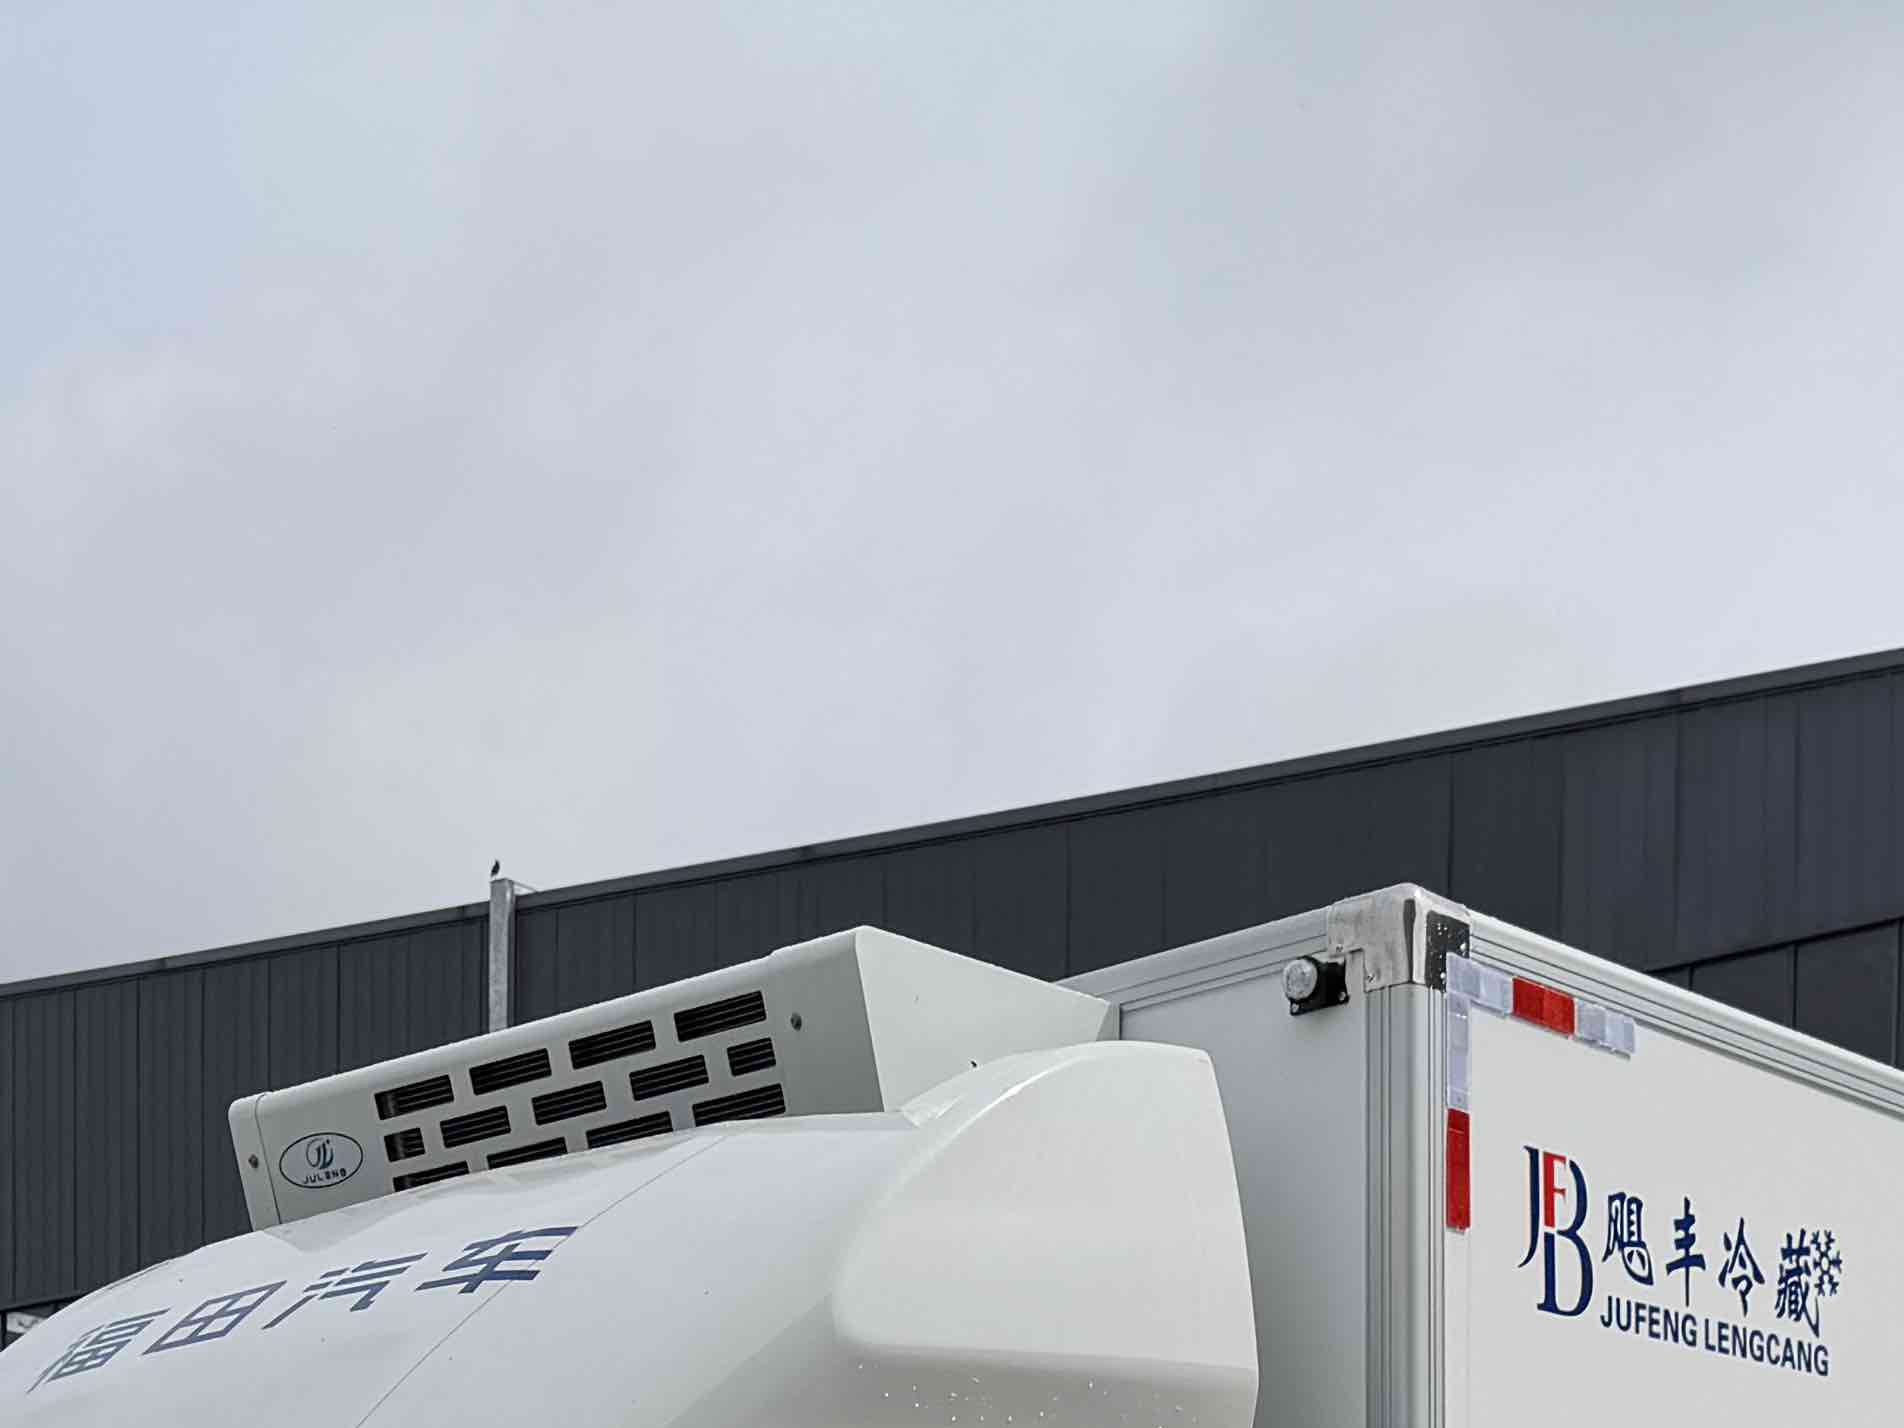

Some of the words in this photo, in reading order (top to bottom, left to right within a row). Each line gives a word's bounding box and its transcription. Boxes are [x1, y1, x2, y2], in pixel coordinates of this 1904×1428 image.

[27, 1225, 579, 1394] 福田汽车
[1600, 1294, 1698, 1349] JUFENG
[1703, 1317, 1830, 1377] LENGCANG
